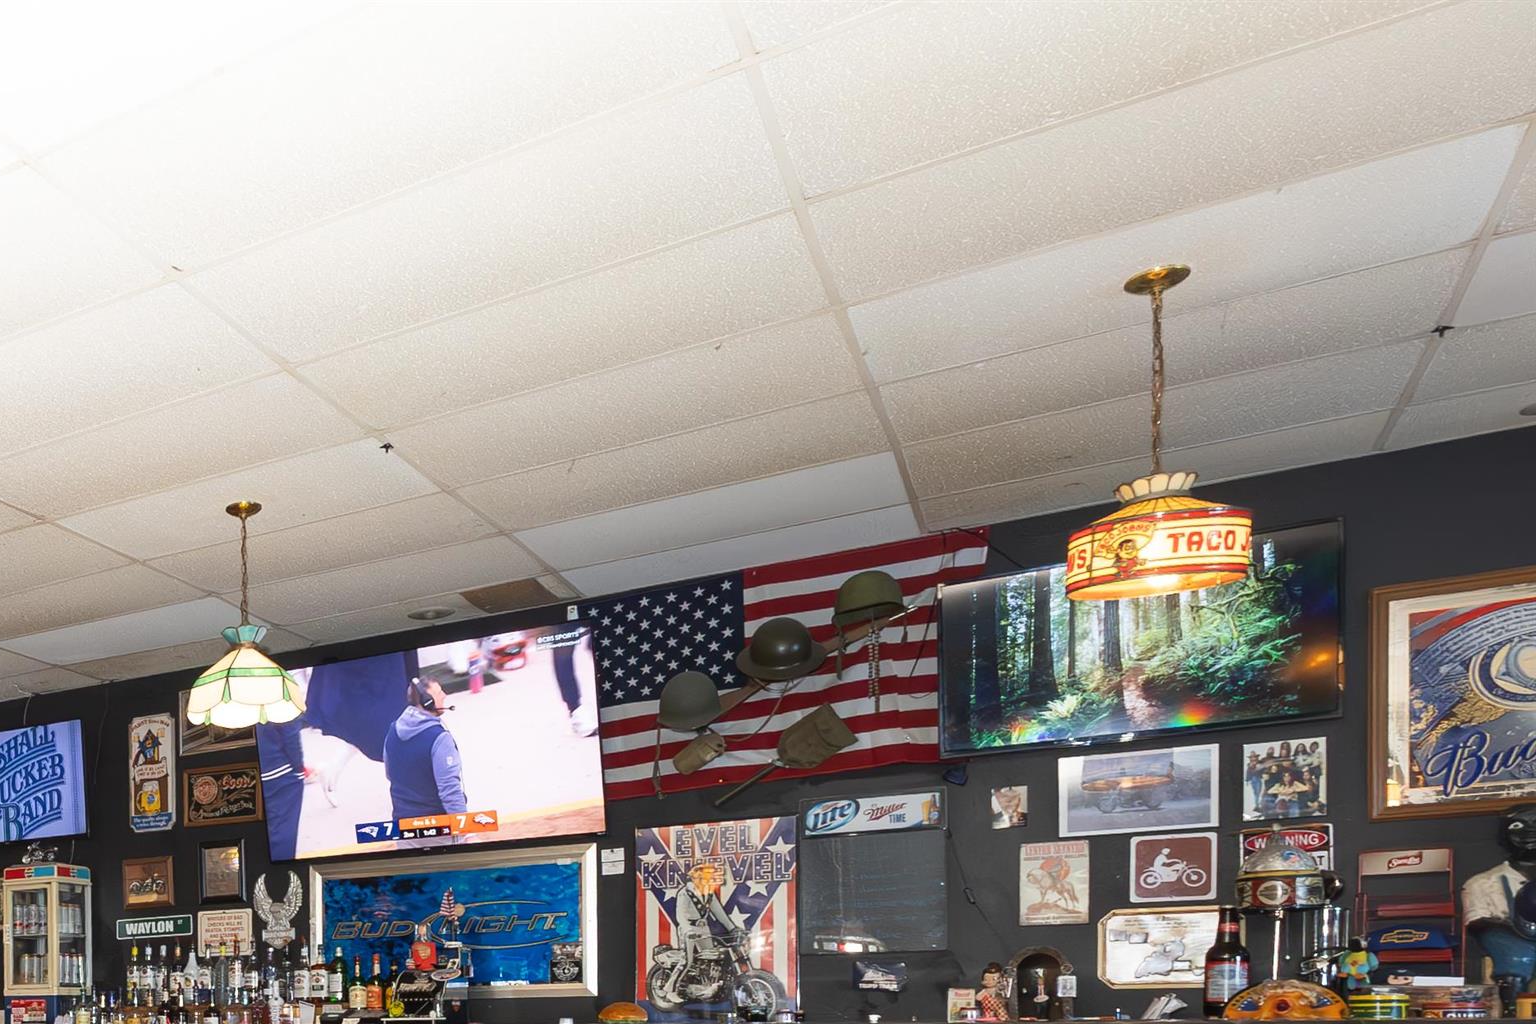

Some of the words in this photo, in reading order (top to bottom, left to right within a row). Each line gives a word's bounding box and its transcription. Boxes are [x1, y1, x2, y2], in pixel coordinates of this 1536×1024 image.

[1167, 530, 1236, 553] TACO
[0, 788, 63, 842] BAND
[456, 815, 467, 829] 7
[812, 802, 853, 832] Lite
[863, 803, 907, 822] Miller
[889, 813, 906, 824] TIME
[384, 822, 393, 836] 7
[675, 824, 755, 857] EVEL
[1254, 833, 1320, 849] WNING
[125, 920, 174, 935] WAYLON
[332, 919, 415, 940] BUD
[438, 911, 568, 936] LIGHT
